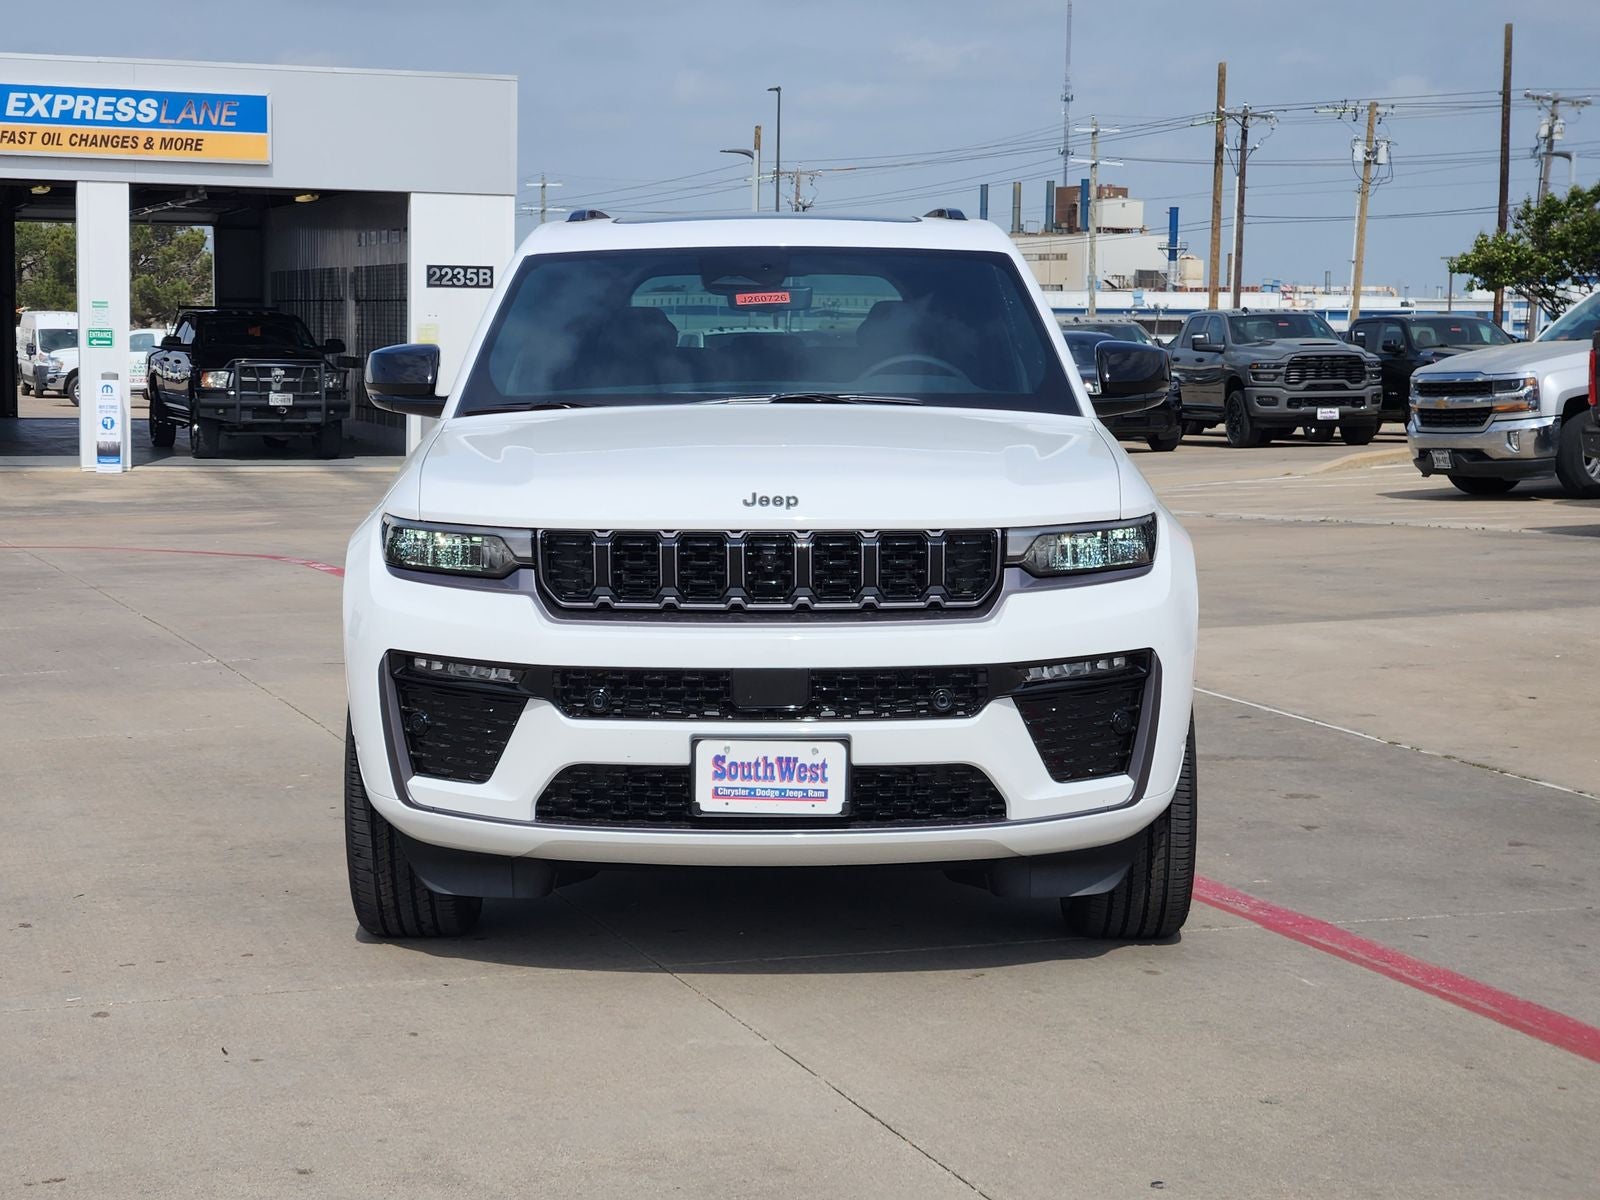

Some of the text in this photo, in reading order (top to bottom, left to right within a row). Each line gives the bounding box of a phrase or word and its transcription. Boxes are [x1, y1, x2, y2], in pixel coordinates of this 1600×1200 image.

[0, 130, 204, 151] FAST OIL CHANGES & MORE
[428, 267, 492, 286] 2235B
[740, 294, 787, 304] J260726
[742, 492, 799, 510] Jeep
[717, 787, 825, 798] Chrysler Dodge Jeep Ram
